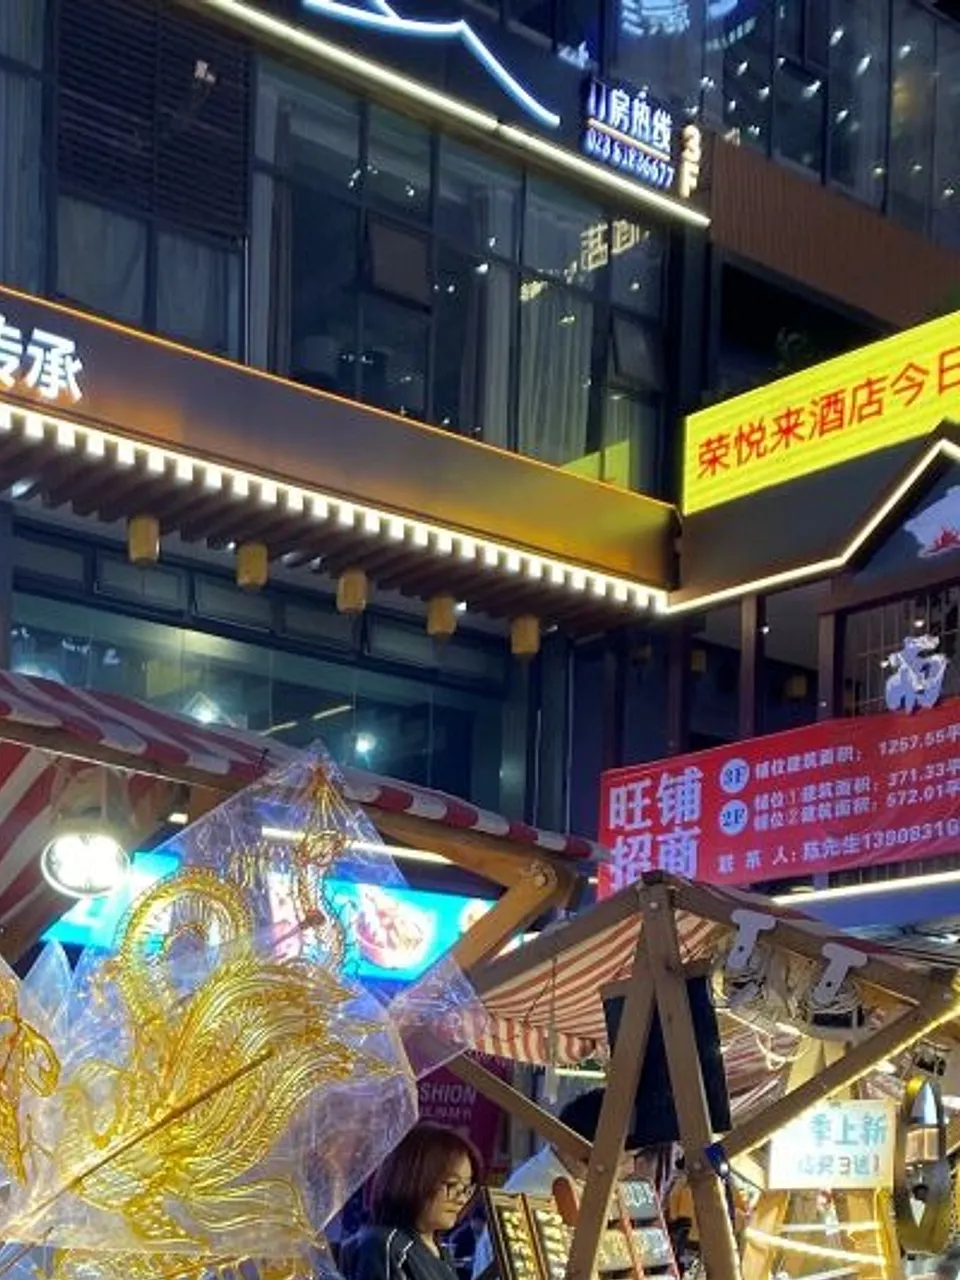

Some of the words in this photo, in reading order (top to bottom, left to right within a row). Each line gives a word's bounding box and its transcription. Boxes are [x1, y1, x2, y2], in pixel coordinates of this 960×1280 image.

[696, 346, 960, 480] 荣悦来酒店今日
[608, 765, 704, 830] 旺铺
[609, 826, 702, 889] 招商
